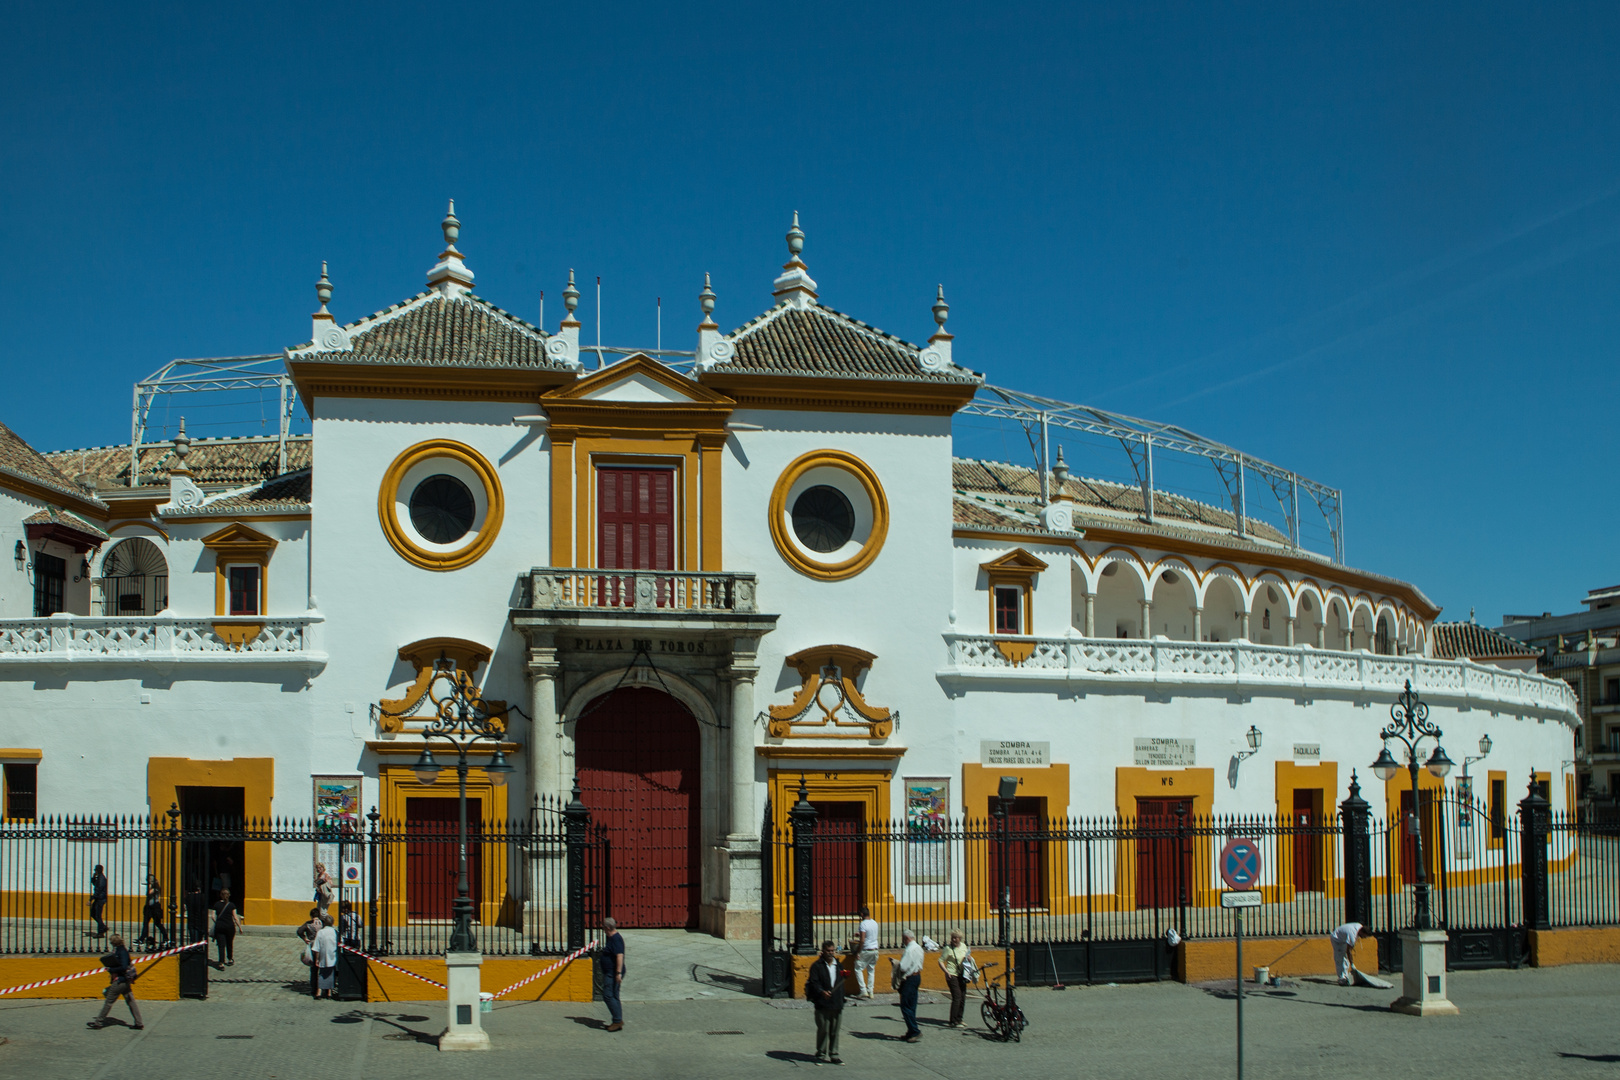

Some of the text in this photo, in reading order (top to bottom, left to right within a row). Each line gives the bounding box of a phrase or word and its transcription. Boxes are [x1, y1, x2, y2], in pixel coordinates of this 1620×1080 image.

[575, 638, 705, 653] PLAZA DE TOROS
[1293, 747, 1320, 756] TAQUILLAS
[1403, 751, 1427, 759] TALAS
[1168, 777, 1174, 786] 6
